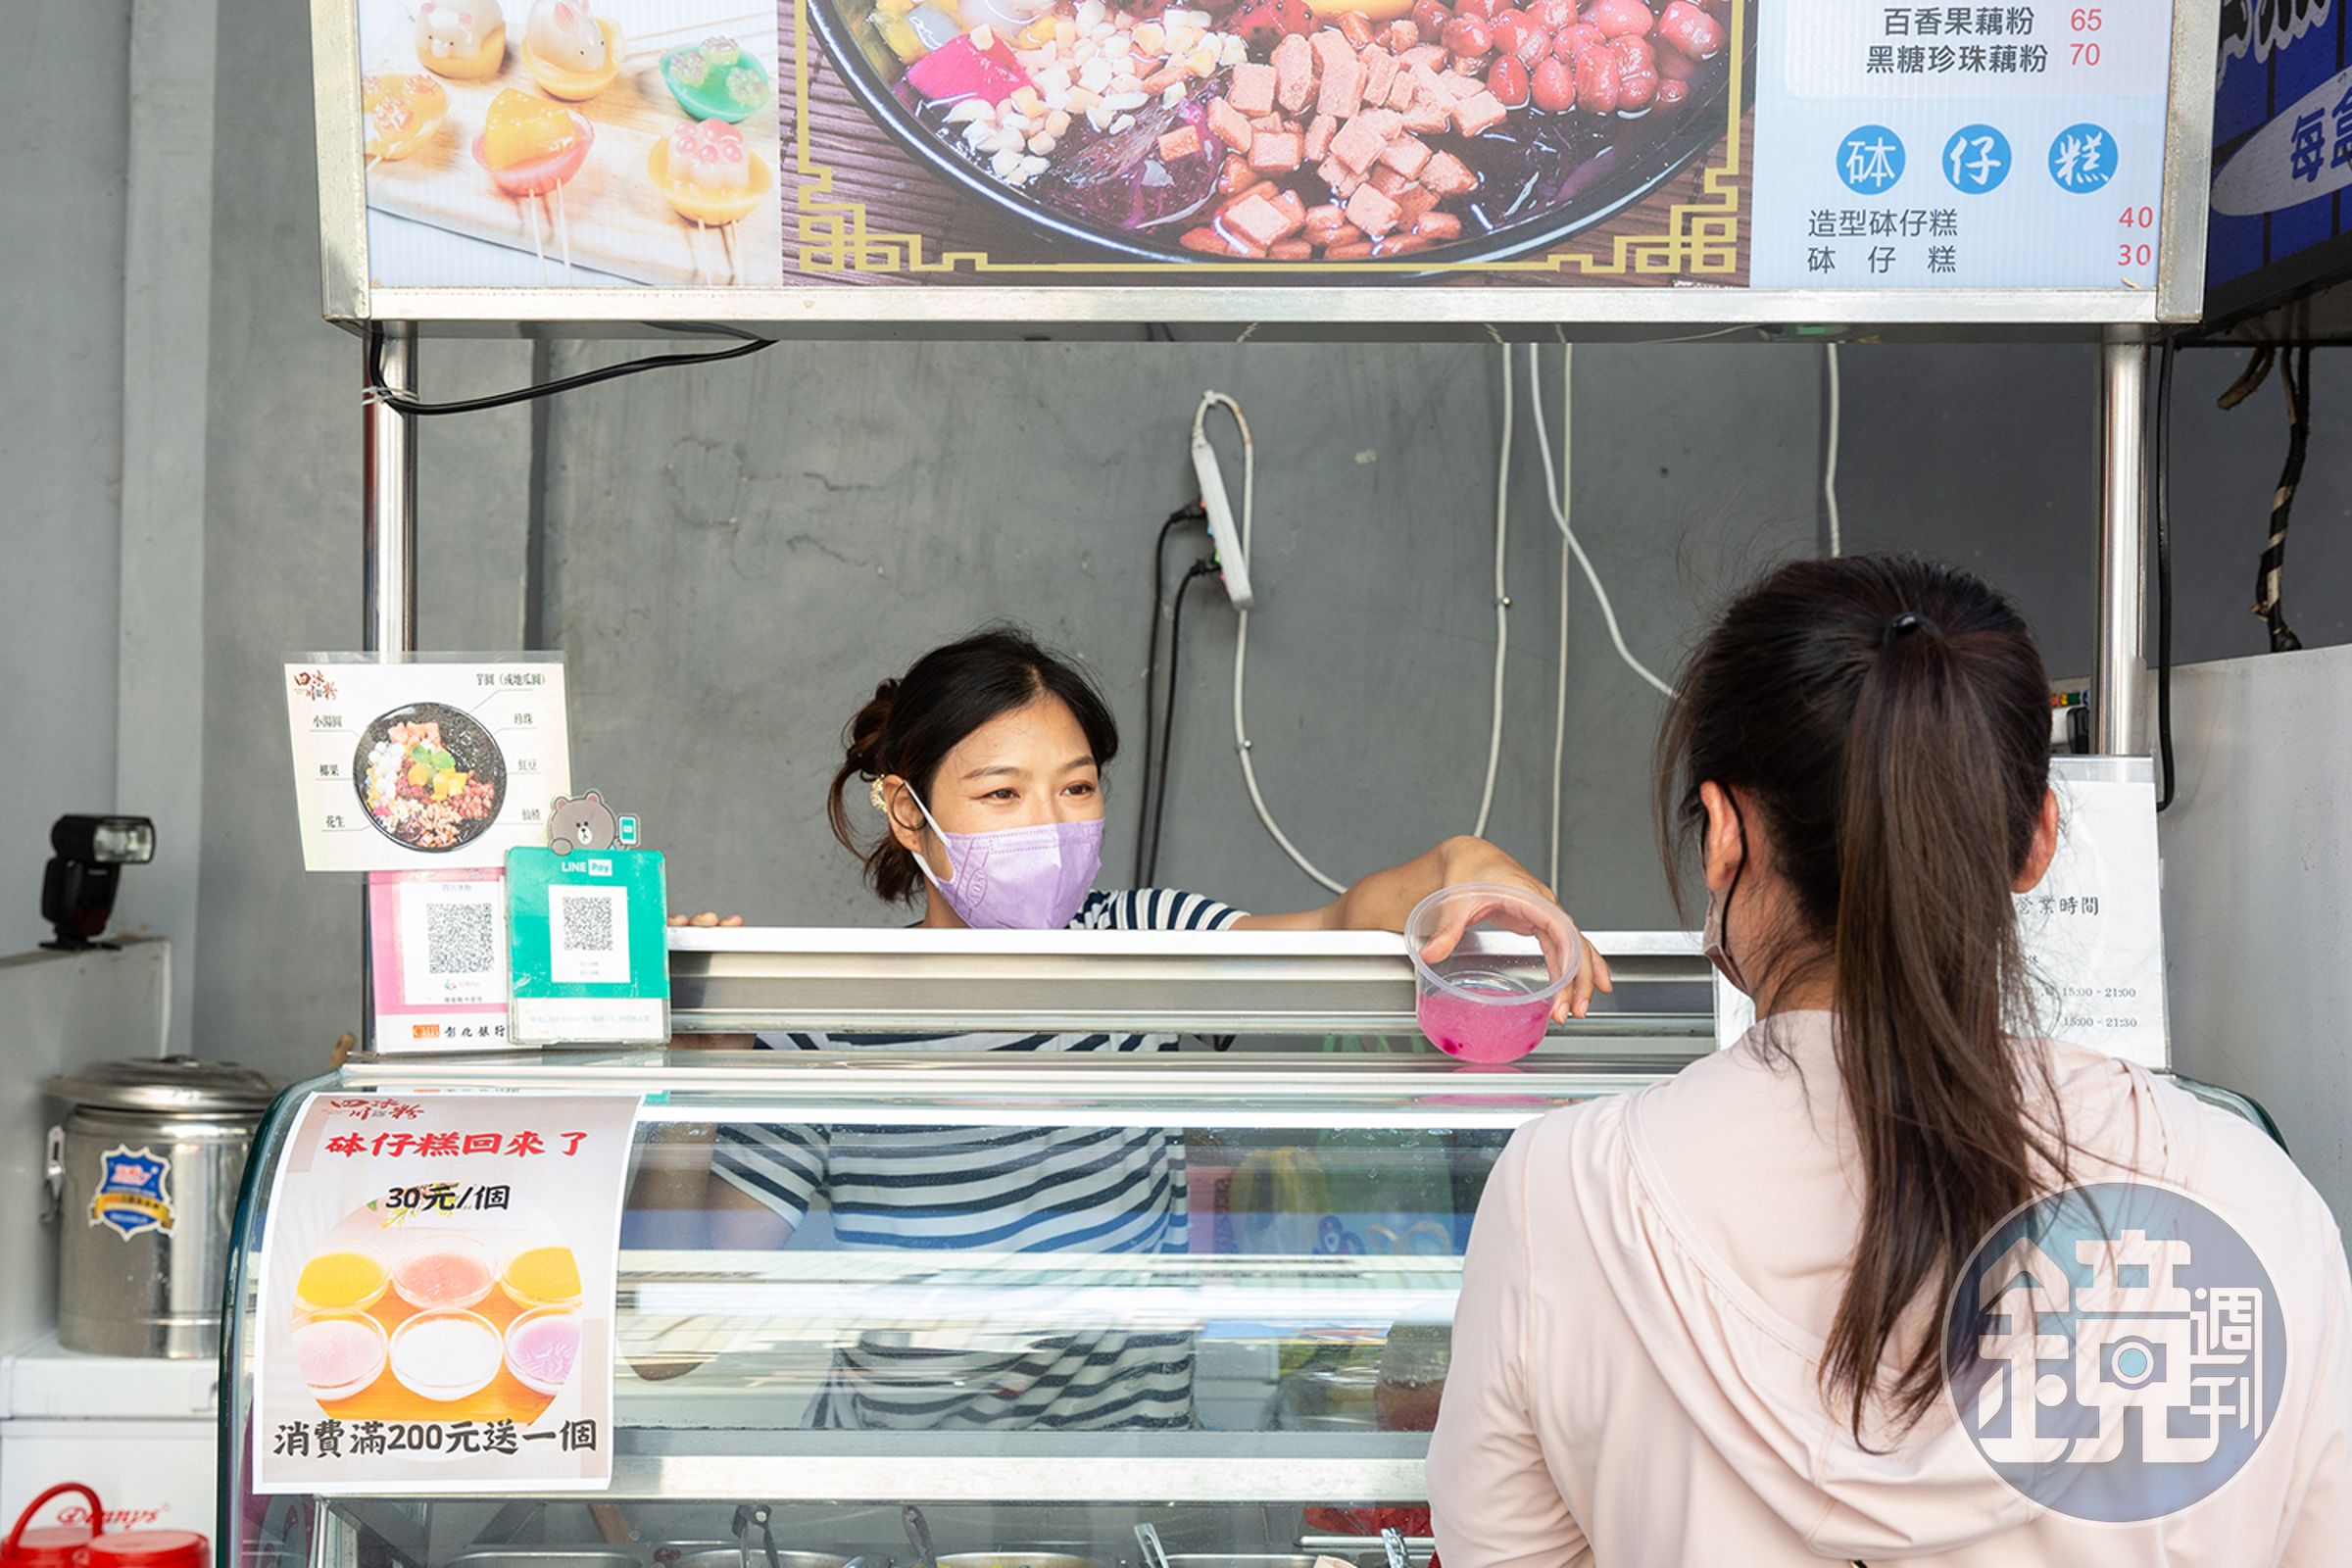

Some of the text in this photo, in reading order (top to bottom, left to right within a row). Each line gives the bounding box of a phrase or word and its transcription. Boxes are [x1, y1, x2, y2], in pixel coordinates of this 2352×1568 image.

[1885, 7, 2102, 35] 百香果藕粉 65
[1867, 43, 2100, 74] 黑糖珍珠藕粉 70
[1808, 207, 2153, 237] 造型砵仔糕 40
[2119, 244, 2151, 266] 30
[326, 815, 345, 828] 花生
[562, 861, 610, 873] LINE Pay
[2062, 988, 2093, 998] 15:00
[2105, 988, 2136, 998] 21:00
[2063, 1017, 2094, 1027] 15:00
[2106, 1017, 2137, 1027] 21:30
[325, 1130, 587, 1158] 砵仔糕回來了
[385, 1184, 511, 1211] 30元/個
[273, 1418, 597, 1459] 消費滿200元送一個
